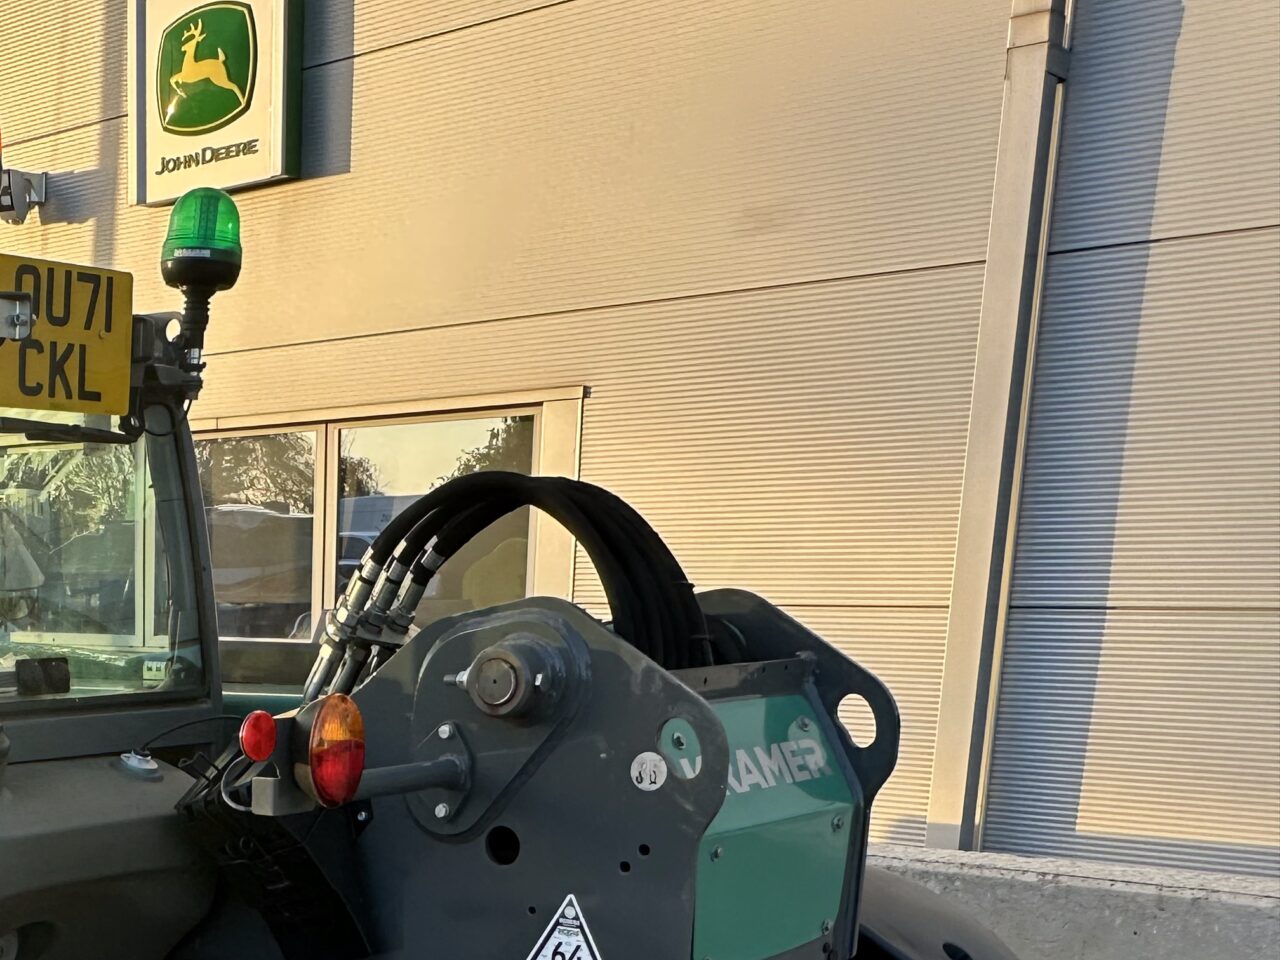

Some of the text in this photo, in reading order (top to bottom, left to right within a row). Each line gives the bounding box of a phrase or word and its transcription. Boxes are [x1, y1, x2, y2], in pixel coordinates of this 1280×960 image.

[155, 139, 259, 175] JOHN DEERE
[15, 264, 113, 333] OU71
[18, 339, 102, 402] CKL
